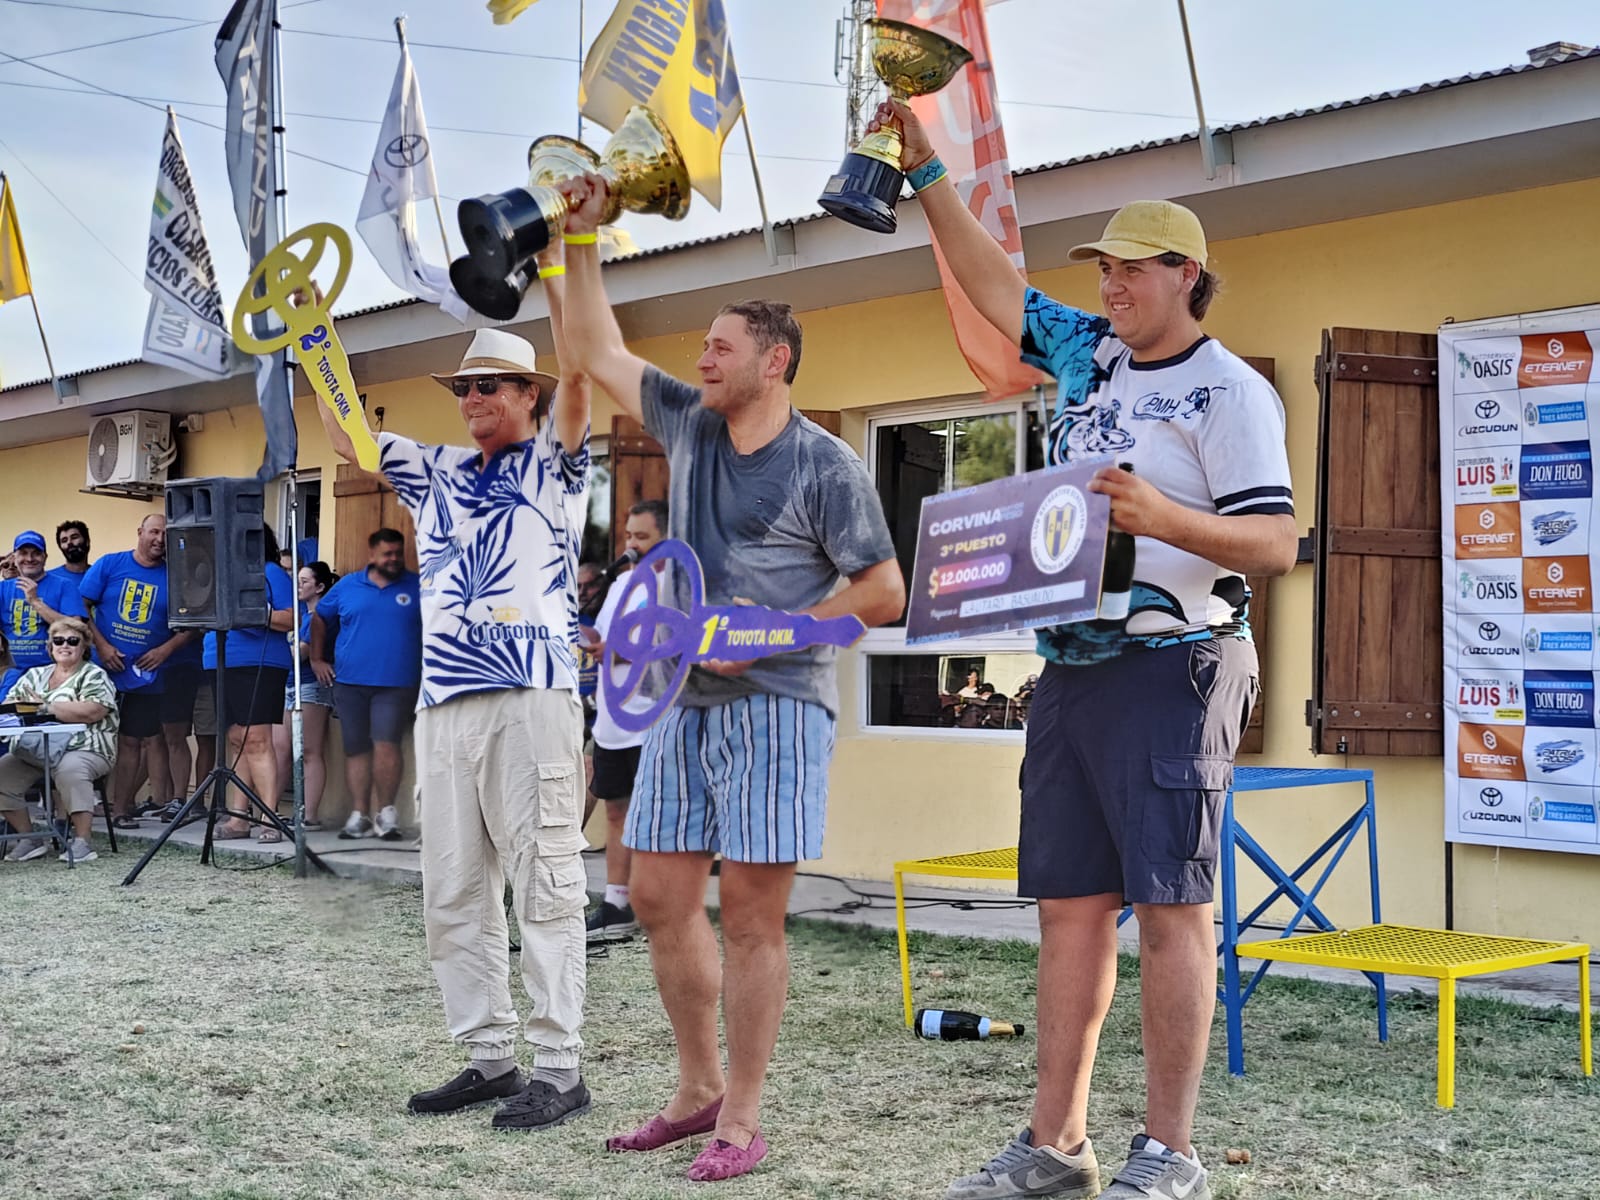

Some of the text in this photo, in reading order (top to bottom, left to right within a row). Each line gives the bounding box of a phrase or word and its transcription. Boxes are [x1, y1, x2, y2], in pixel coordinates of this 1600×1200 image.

[1474, 358, 1513, 379] OASIS
[1524, 360, 1585, 373] ETERNET
[316, 355, 340, 396] TOYOTA
[1541, 411, 1584, 422] TRES ARROYOS
[120, 424, 133, 436] BGH
[1464, 424, 1518, 435] UZCUDUN
[1457, 464, 1496, 486] LUIS
[1530, 463, 1582, 482] DON HUGO
[928, 508, 1002, 537] CORVINA
[954, 533, 1007, 554] PUESTO
[1461, 532, 1515, 545] ETERNET
[1477, 582, 1517, 600] OASIS
[1528, 587, 1585, 599] ETERNET
[466, 621, 551, 650] Corona
[727, 628, 766, 647] TOYOTA
[1468, 647, 1520, 655] UZCUDUN
[1543, 642, 1590, 650] TRES ARROYOS
[1459, 686, 1501, 706] LUIS
[1534, 692, 1584, 709] DON HUGO
[1463, 753, 1518, 766] ETERNET
[1470, 812, 1522, 823] UZCUDUN
[1547, 811, 1593, 822] TRES ARROYOS
